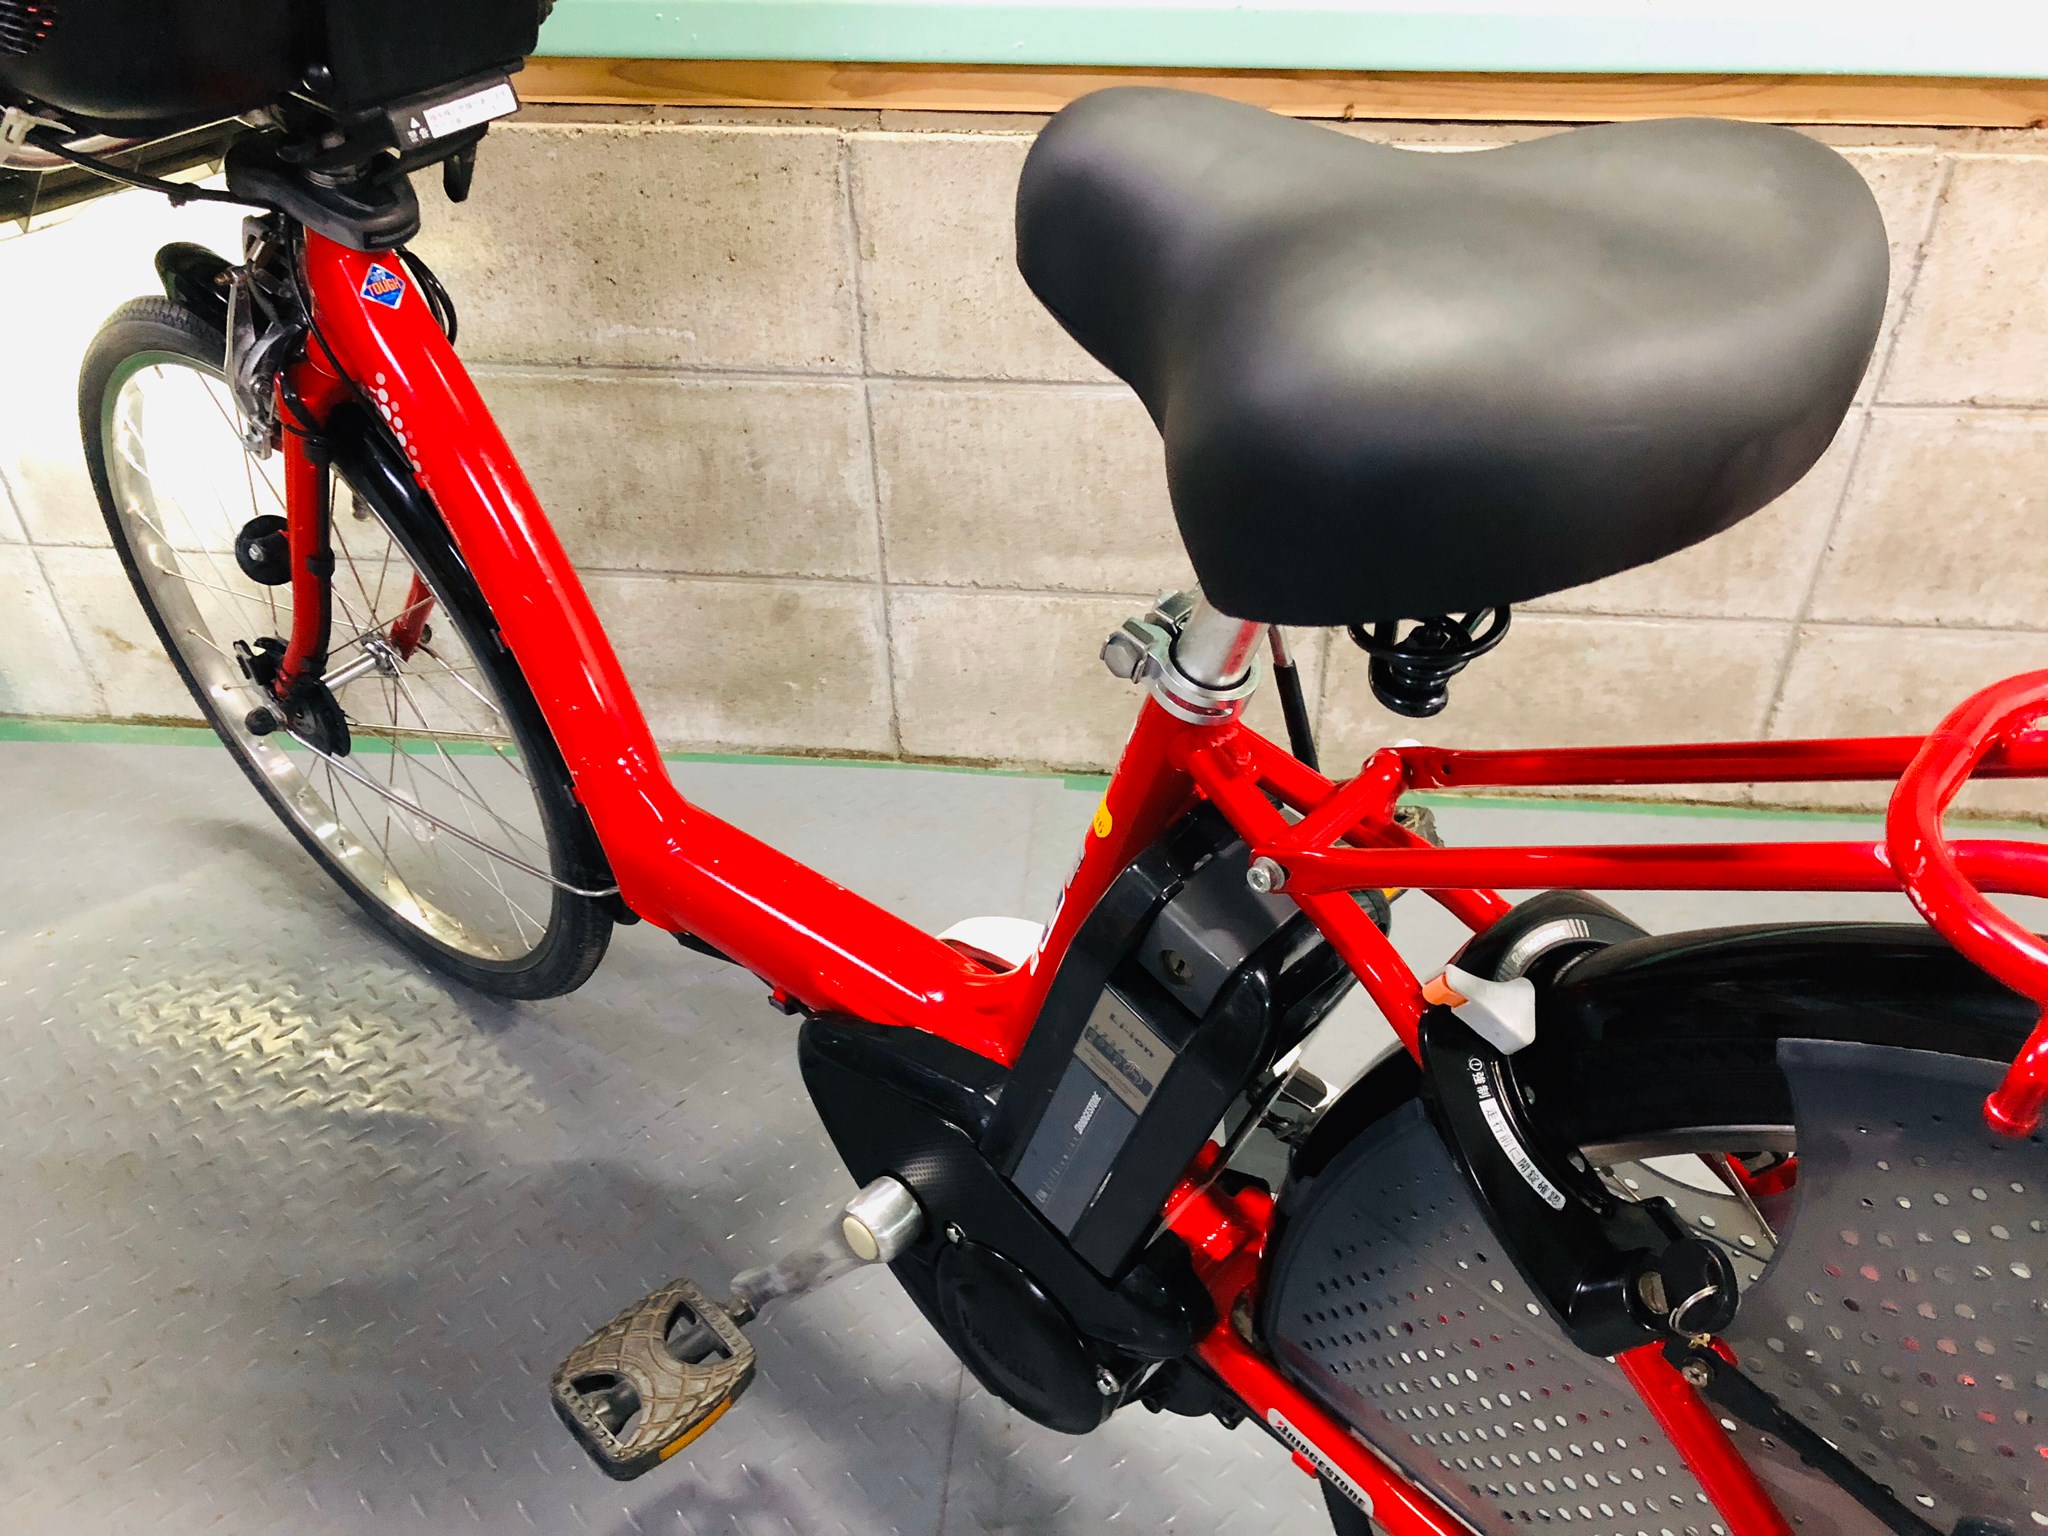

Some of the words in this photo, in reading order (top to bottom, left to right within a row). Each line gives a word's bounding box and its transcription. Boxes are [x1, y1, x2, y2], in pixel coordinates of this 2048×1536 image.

[366, 278, 402, 297] TOUGH
[1109, 1013, 1154, 1058] Li-ion
[1073, 1091, 1103, 1136] BRIDGESTONE
[1275, 1420, 1367, 1511] BRIDGESTONE
